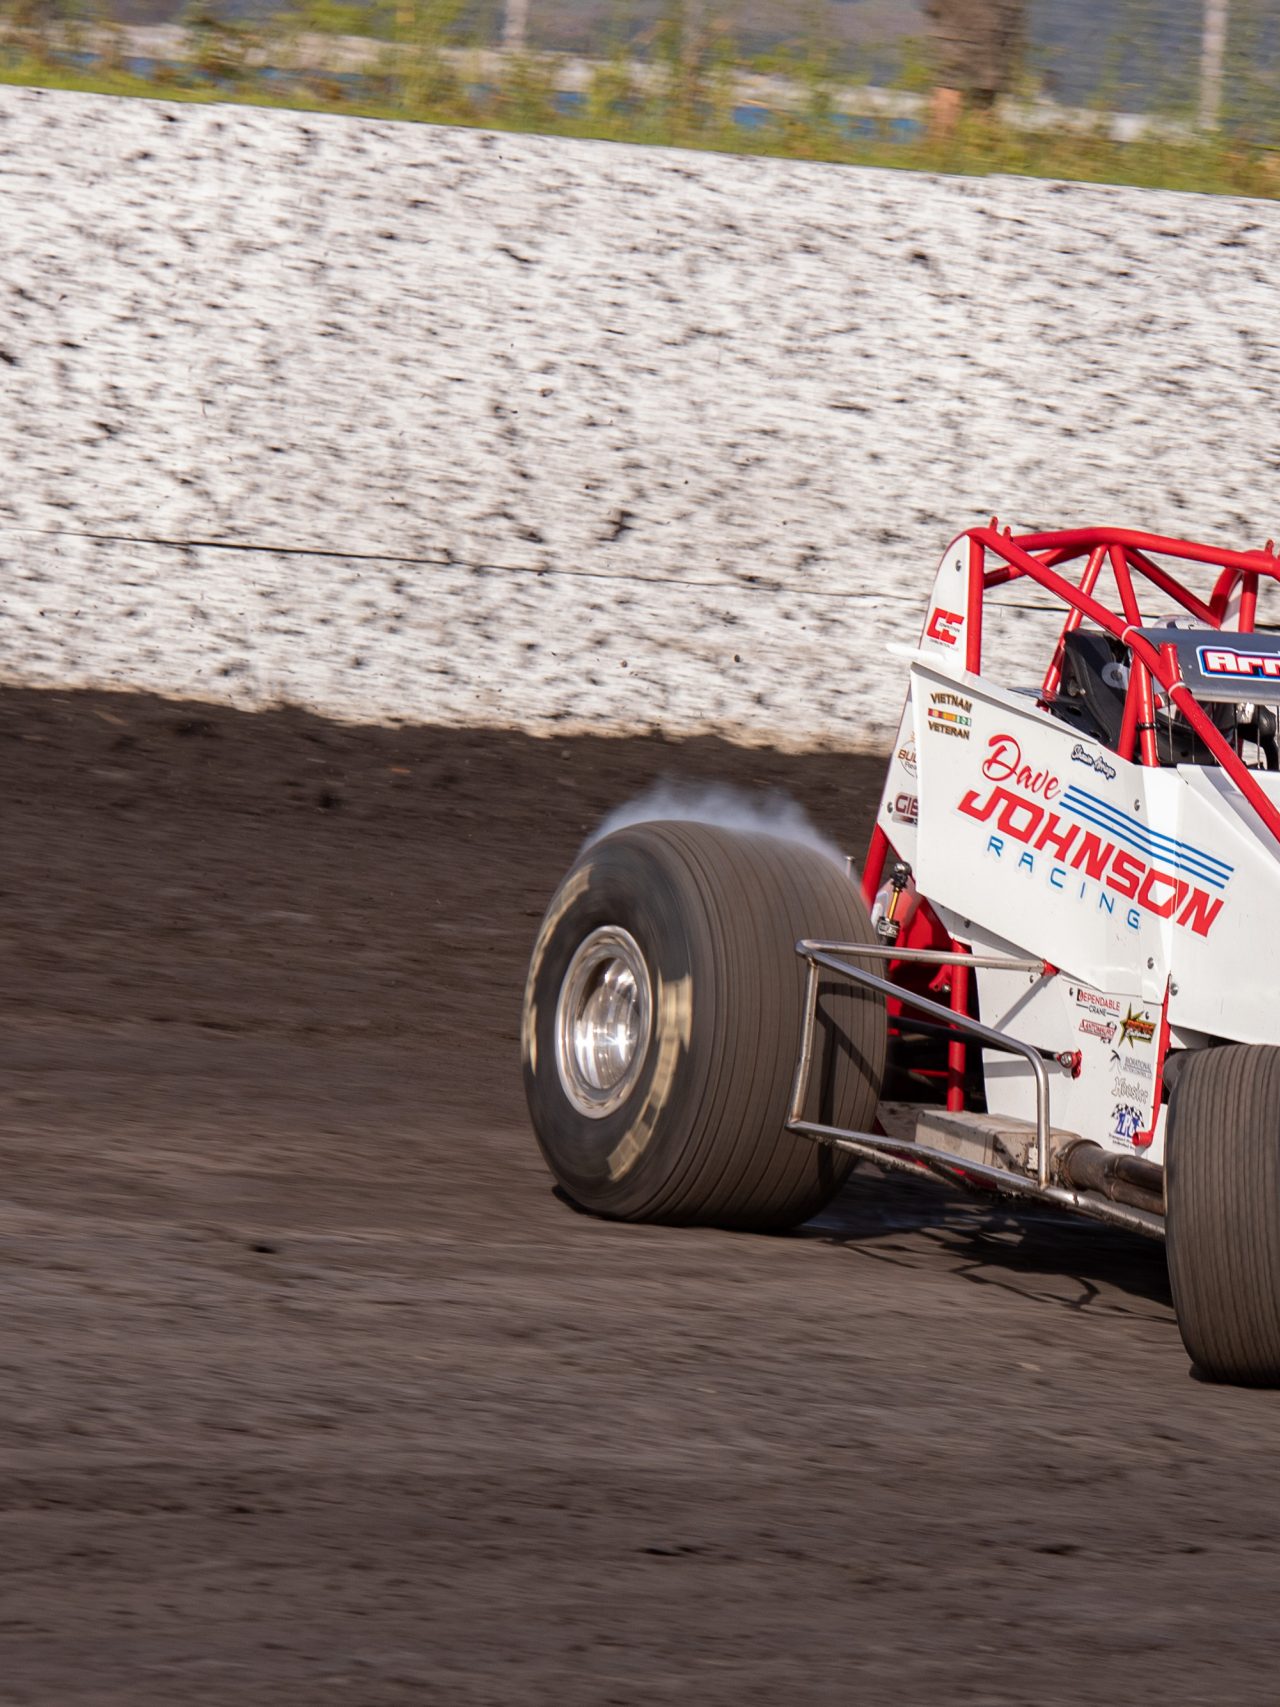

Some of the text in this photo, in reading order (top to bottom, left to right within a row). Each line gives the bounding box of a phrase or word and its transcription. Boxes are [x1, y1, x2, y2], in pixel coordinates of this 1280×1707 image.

[930, 692, 973, 714] VIETNAM
[927, 720, 970, 741] VETERAN
[981, 734, 1061, 800] Dave
[957, 785, 1225, 938] JOHNSON
[987, 834, 1141, 930] RACING
[1077, 988, 1121, 1012] DEPENDABLE
[1088, 1004, 1107, 1017] CRANE
